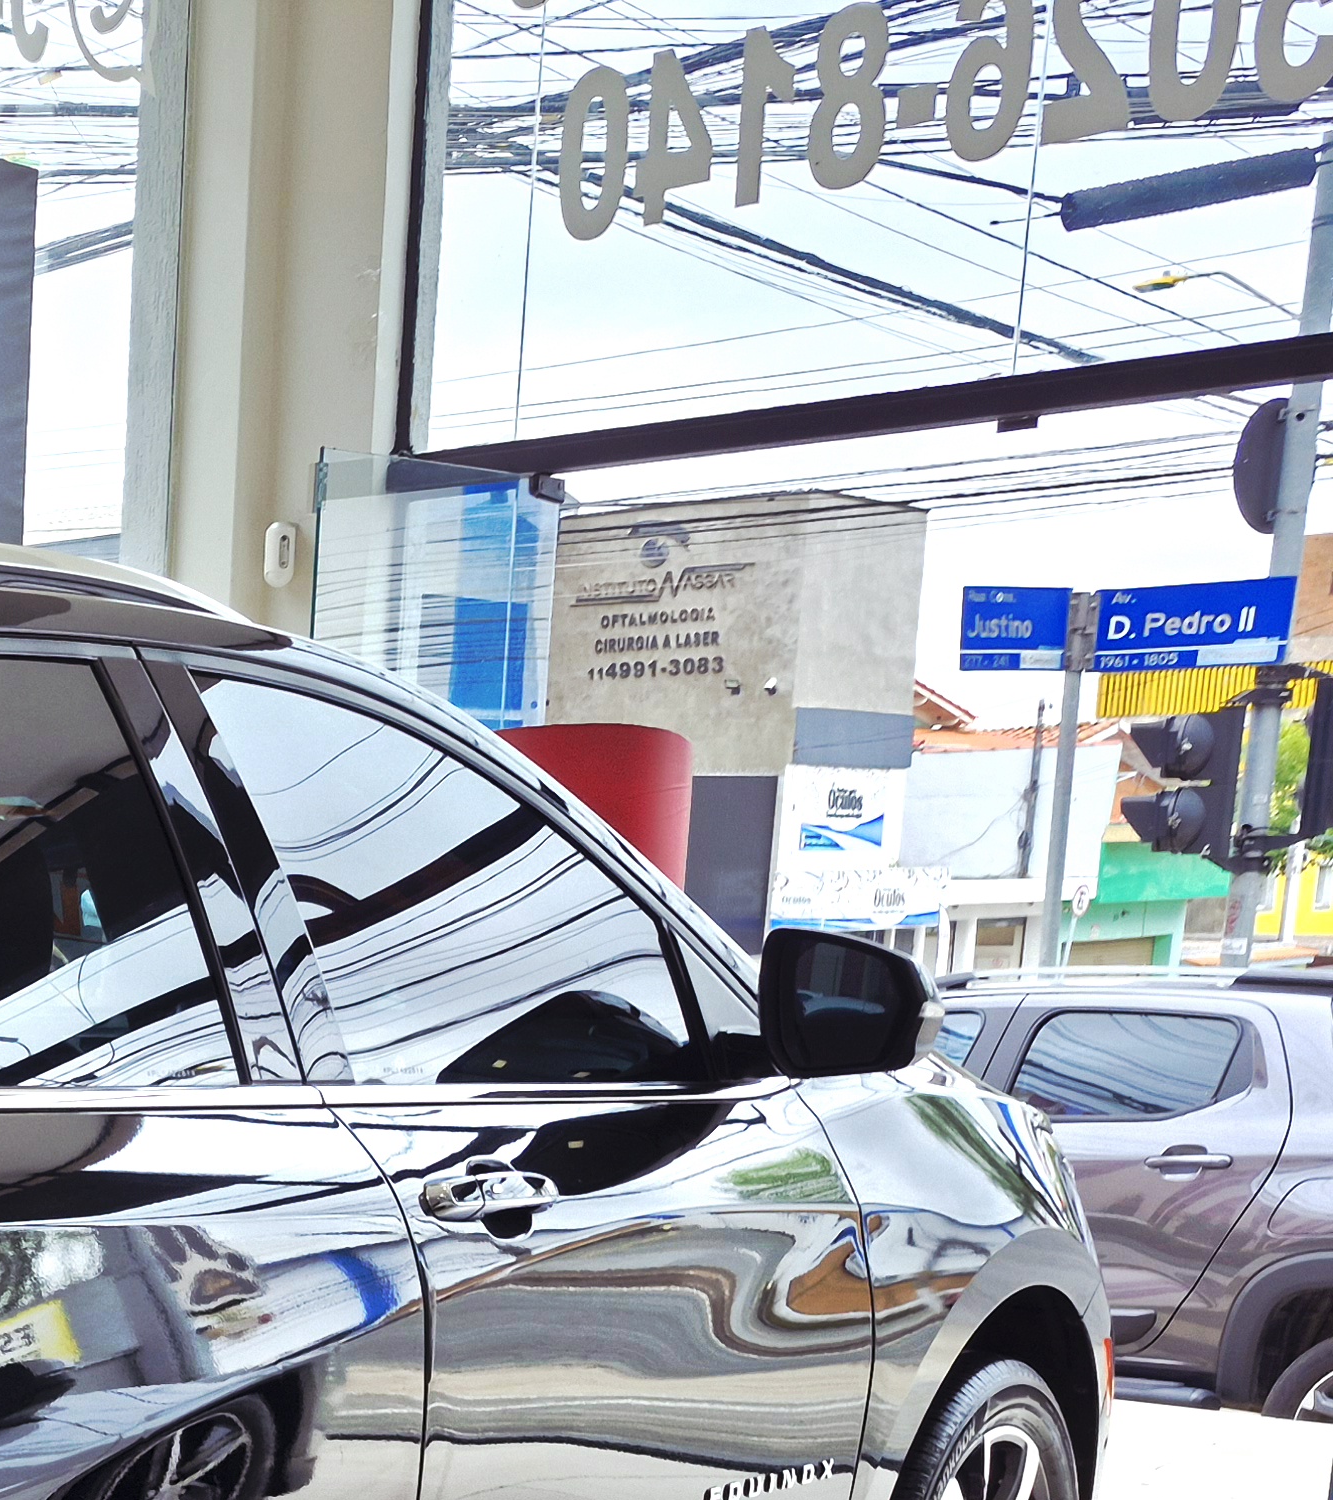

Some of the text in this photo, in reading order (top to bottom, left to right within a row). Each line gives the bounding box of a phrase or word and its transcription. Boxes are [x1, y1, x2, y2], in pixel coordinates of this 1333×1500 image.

[1111, 591, 1137, 605] Av.
[600, 607, 716, 630] OFTALMOLOGIA
[966, 613, 1033, 638] Justino
[1107, 606, 1257, 640] D. Pedro II
[594, 631, 720, 655] CIRURGIA A LASER
[1099, 655, 1129, 669] 1961
